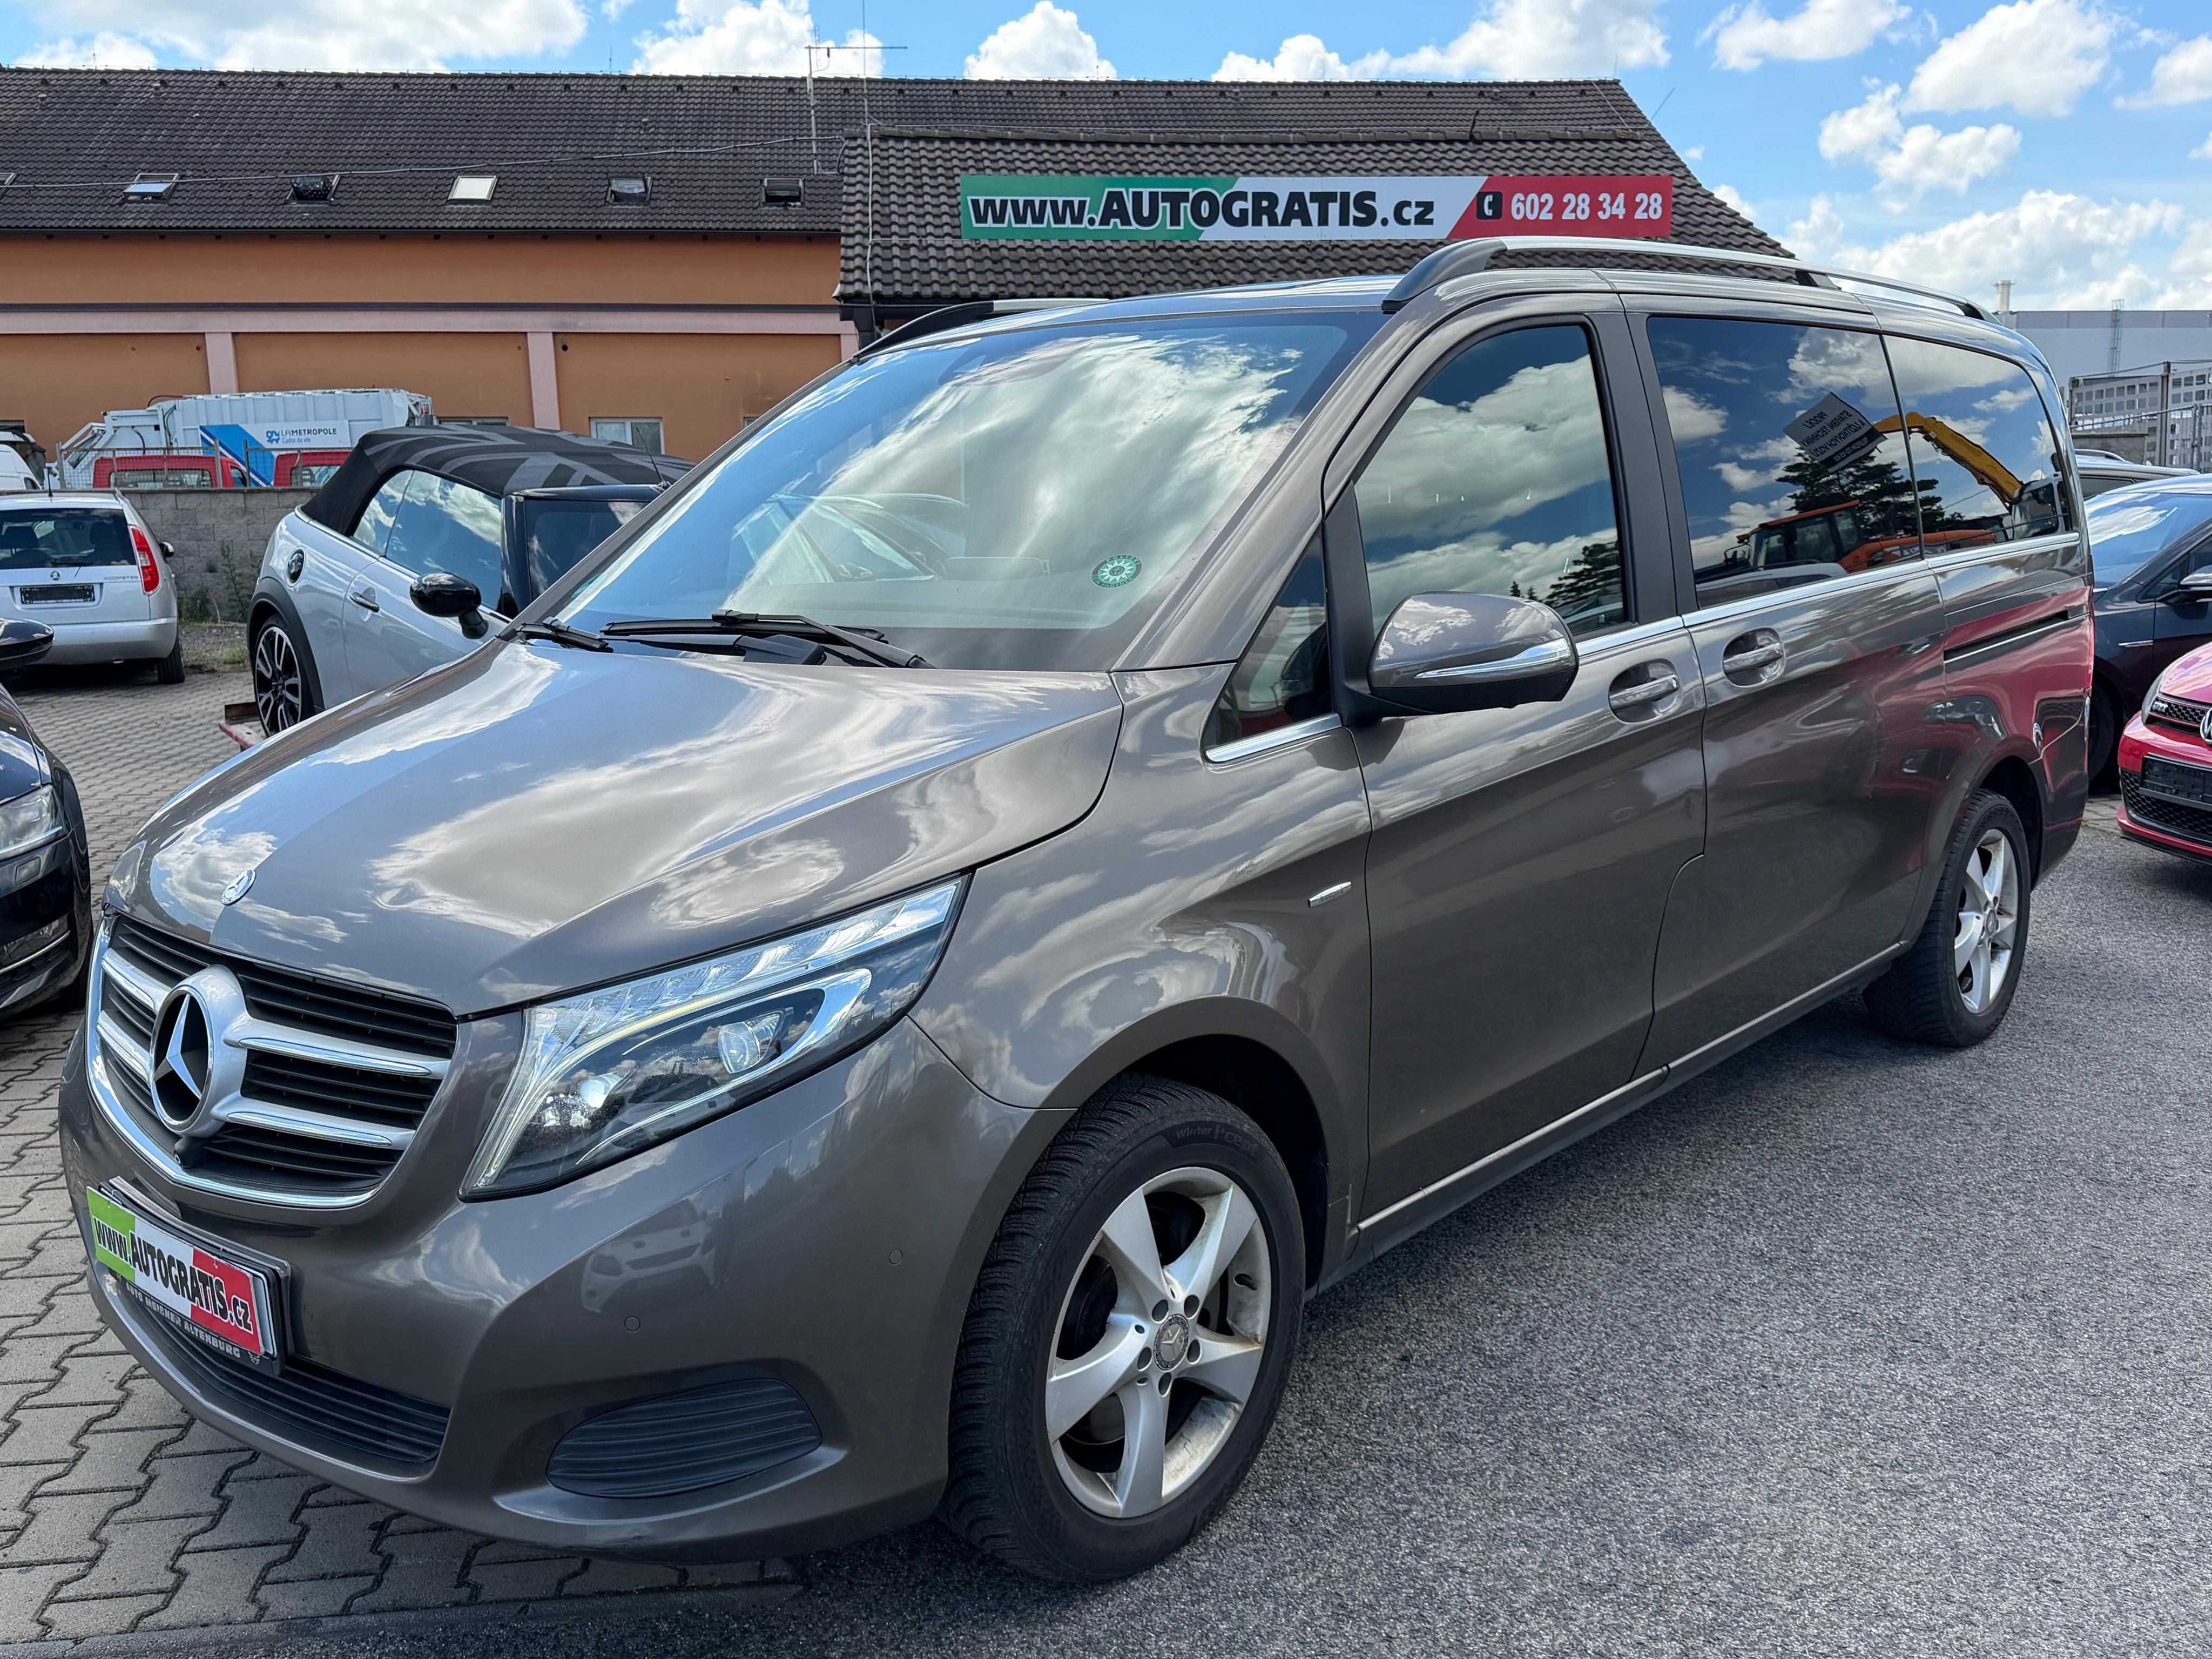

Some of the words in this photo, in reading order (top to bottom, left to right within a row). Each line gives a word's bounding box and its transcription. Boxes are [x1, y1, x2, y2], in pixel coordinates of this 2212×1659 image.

[967, 188, 1434, 229] www.AUTOGRATIS.cz
[1512, 193, 1554, 220] 602
[1562, 193, 1590, 220] 28
[1597, 193, 1626, 219] 34
[1634, 193, 1662, 219] 28
[126, 1282, 143, 1302] AUTO
[184, 1320, 241, 1358] ALTENBURG
